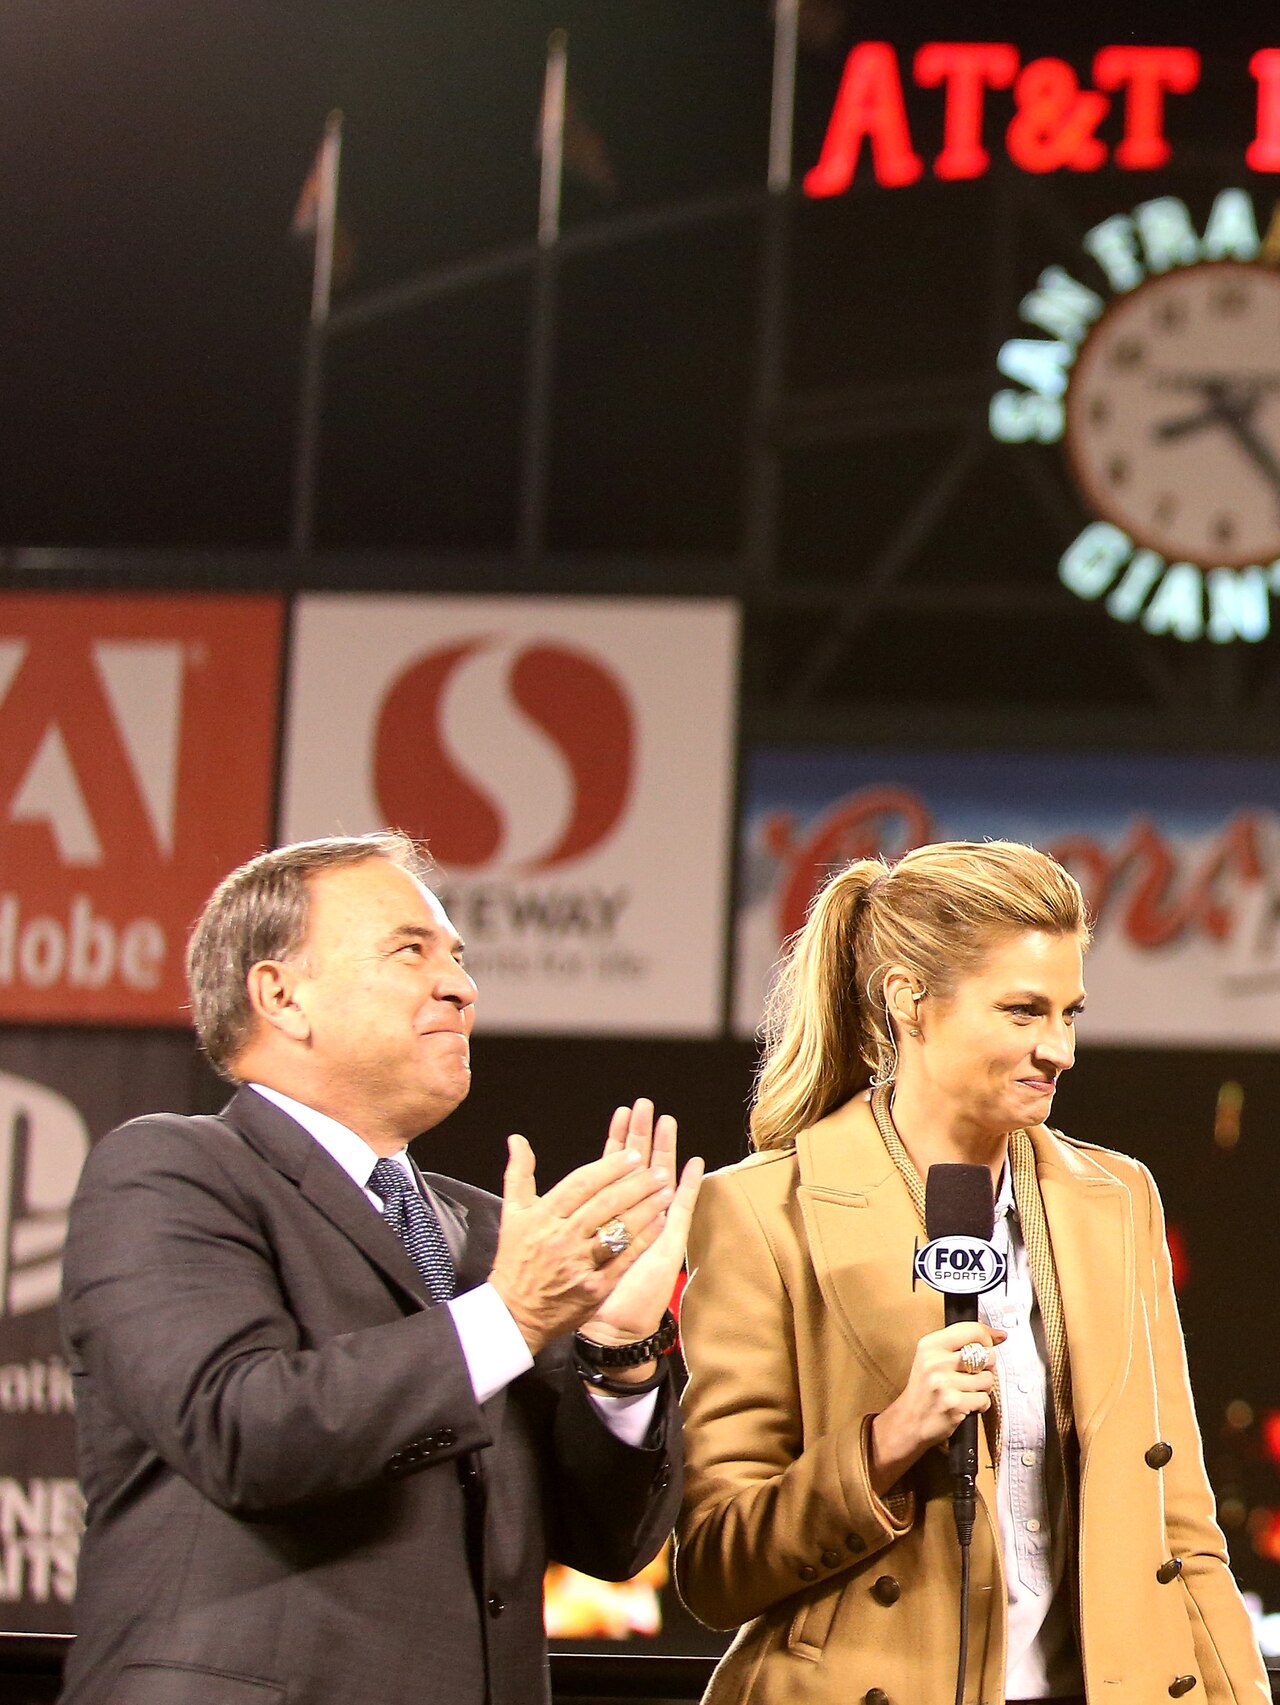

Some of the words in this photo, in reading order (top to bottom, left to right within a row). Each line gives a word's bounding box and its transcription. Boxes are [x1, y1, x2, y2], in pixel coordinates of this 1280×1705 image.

[804, 41, 1200, 197] AT&T
[989, 264, 1104, 444] SAN
[934, 1248, 986, 1272] FOX
[934, 1270, 987, 1281] SPORTS
